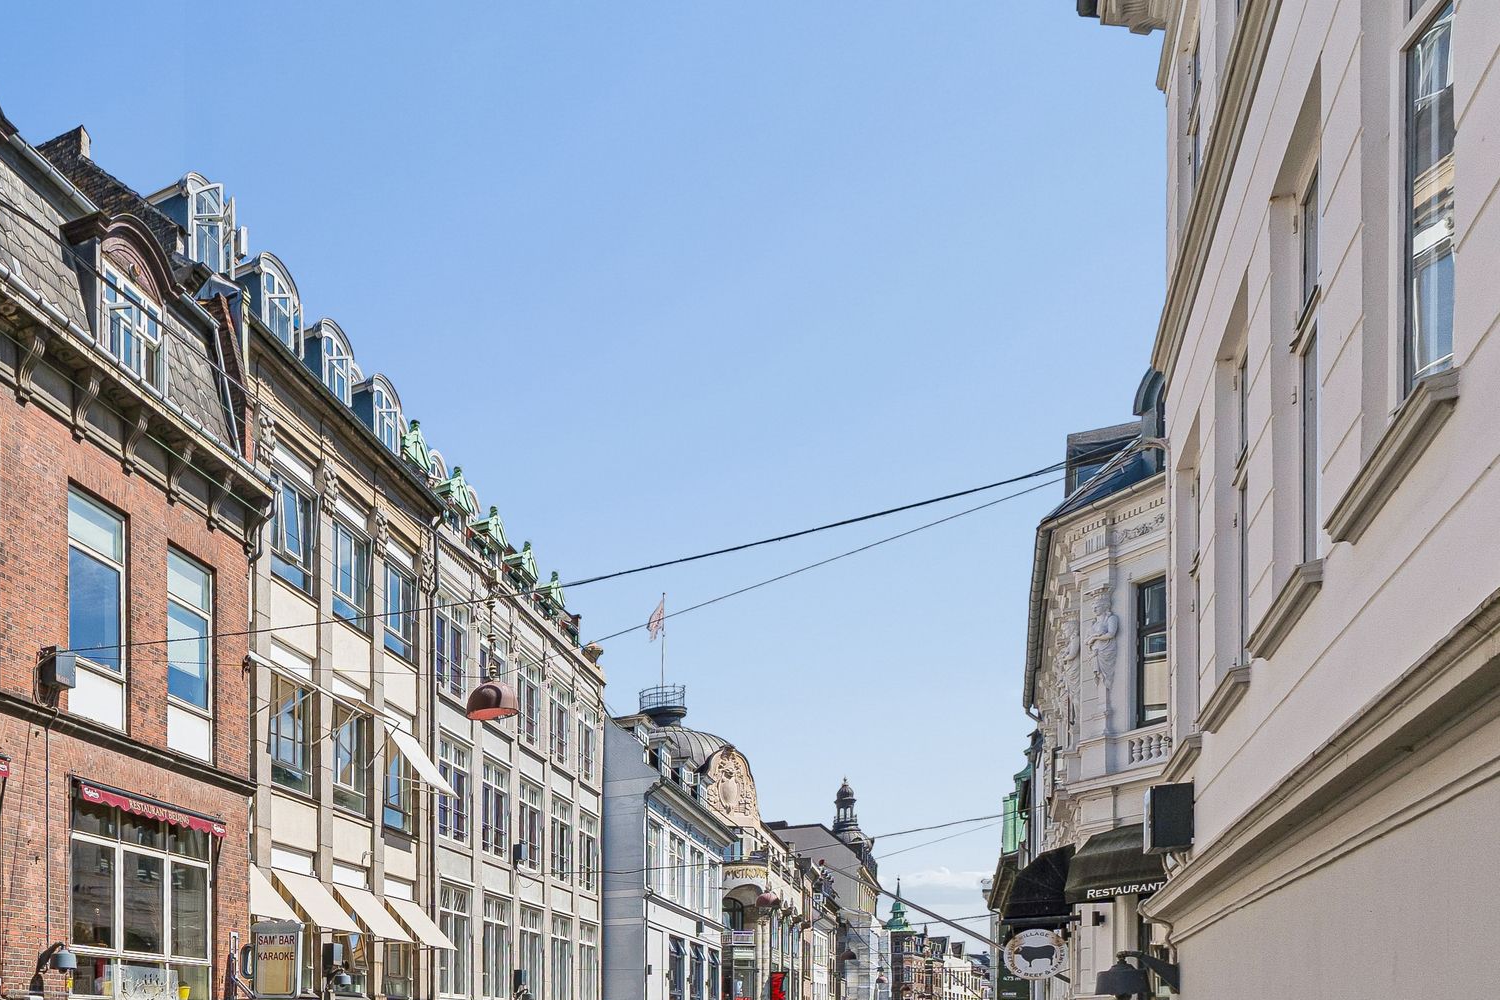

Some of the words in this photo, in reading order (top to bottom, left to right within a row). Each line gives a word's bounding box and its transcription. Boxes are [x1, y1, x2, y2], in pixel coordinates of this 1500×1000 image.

[129, 800, 167, 819] RESTAURANT
[1086, 881, 1165, 899] RESTAURANT
[279, 935, 295, 945] BAR
[258, 951, 295, 961] KARAOKE
